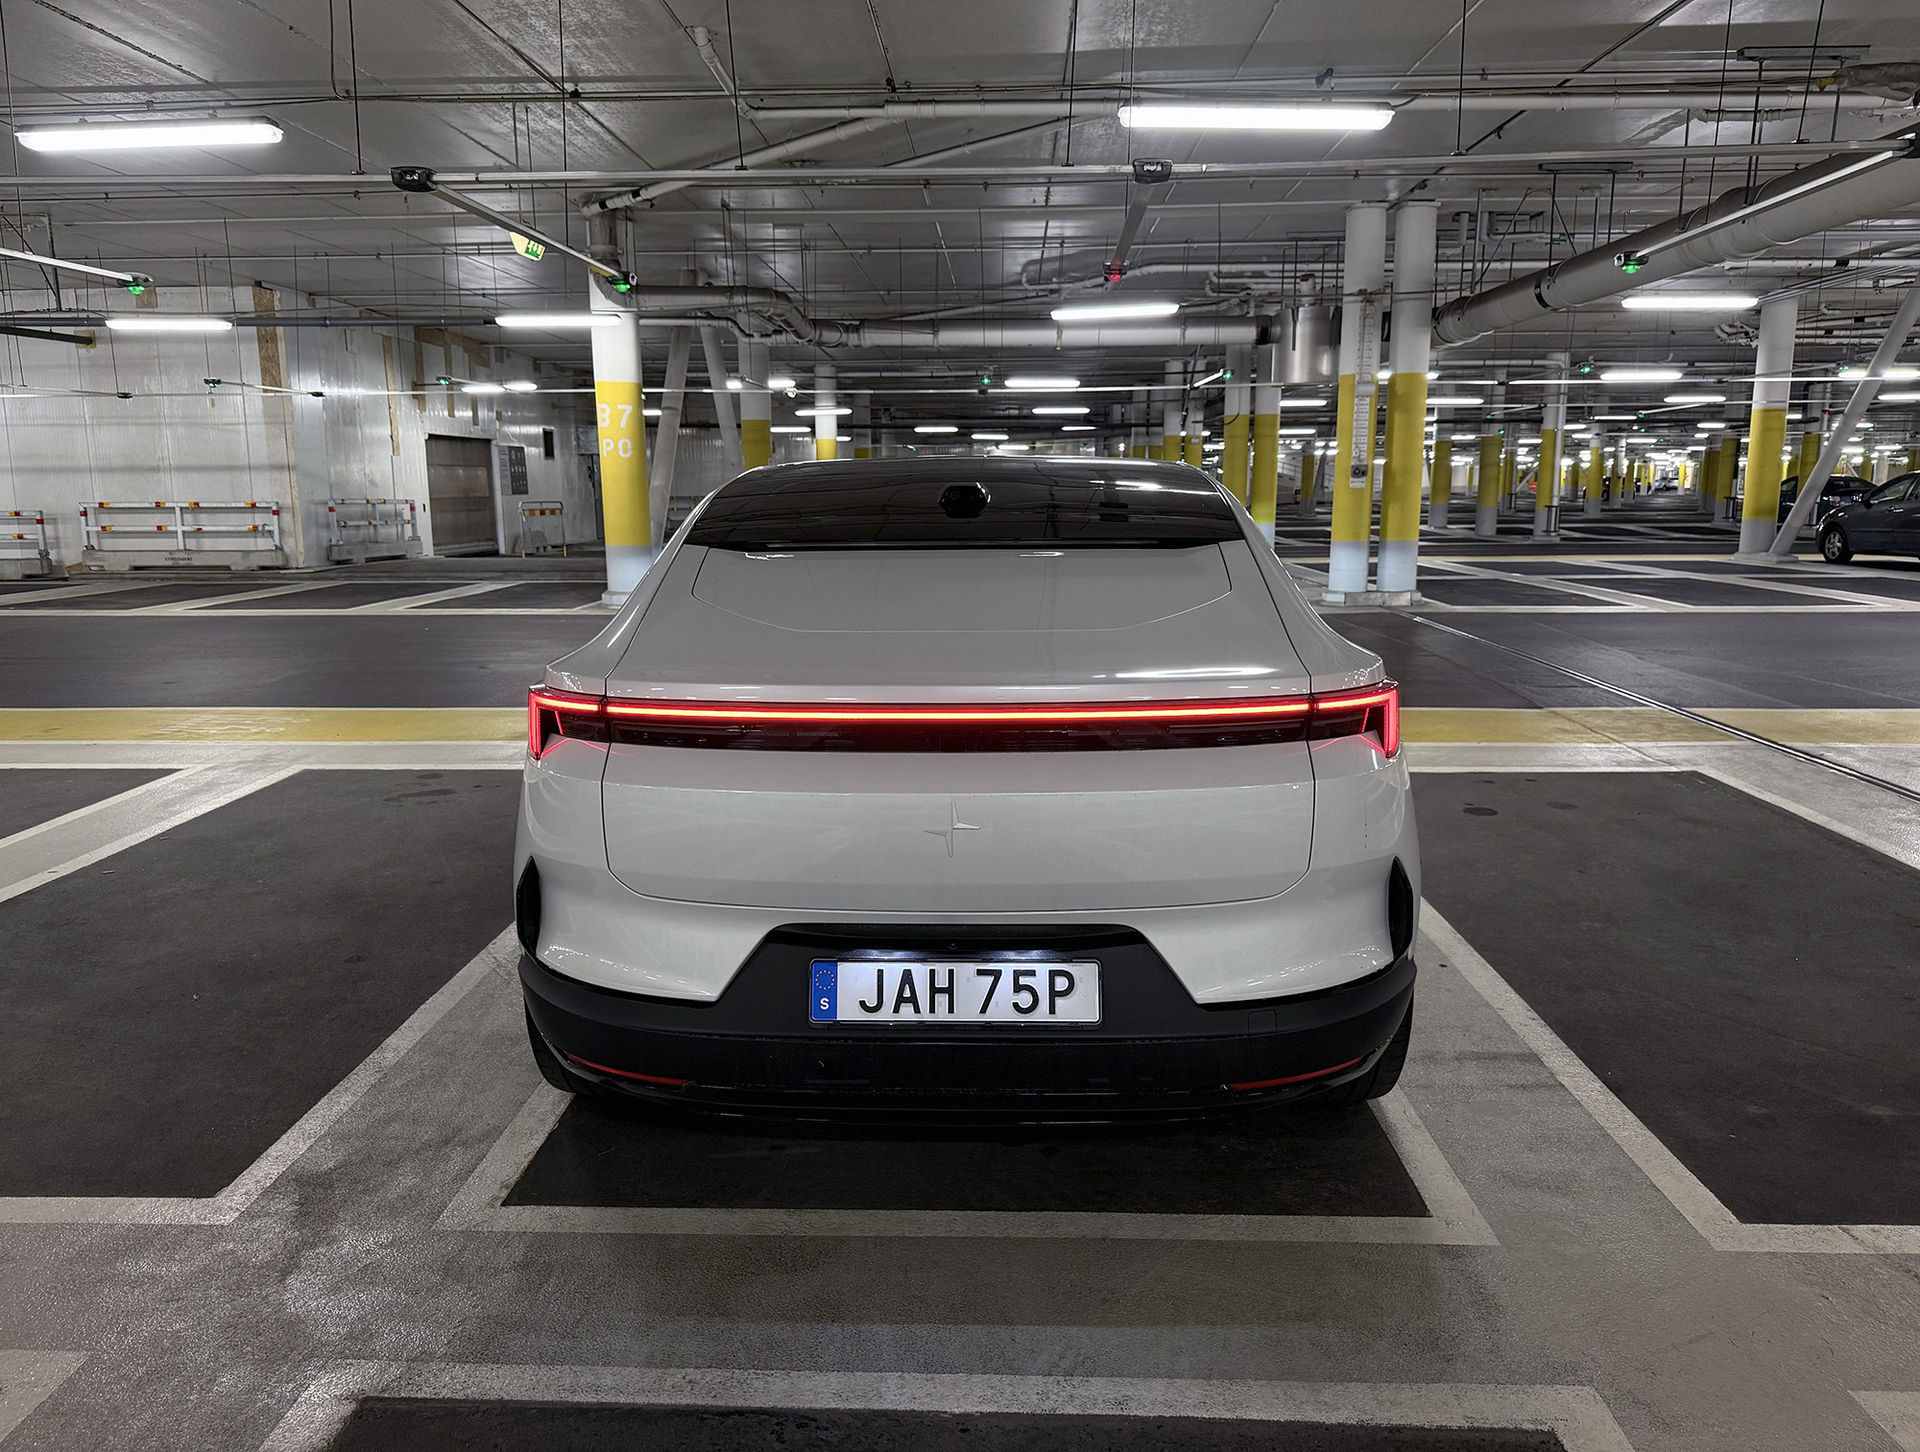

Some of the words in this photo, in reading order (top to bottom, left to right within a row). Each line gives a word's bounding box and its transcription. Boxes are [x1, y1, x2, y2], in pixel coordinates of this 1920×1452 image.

[598, 403, 633, 428] B7
[820, 997, 830, 1010] S
[858, 968, 955, 1014] JAH
[976, 968, 1075, 1015] 75P
